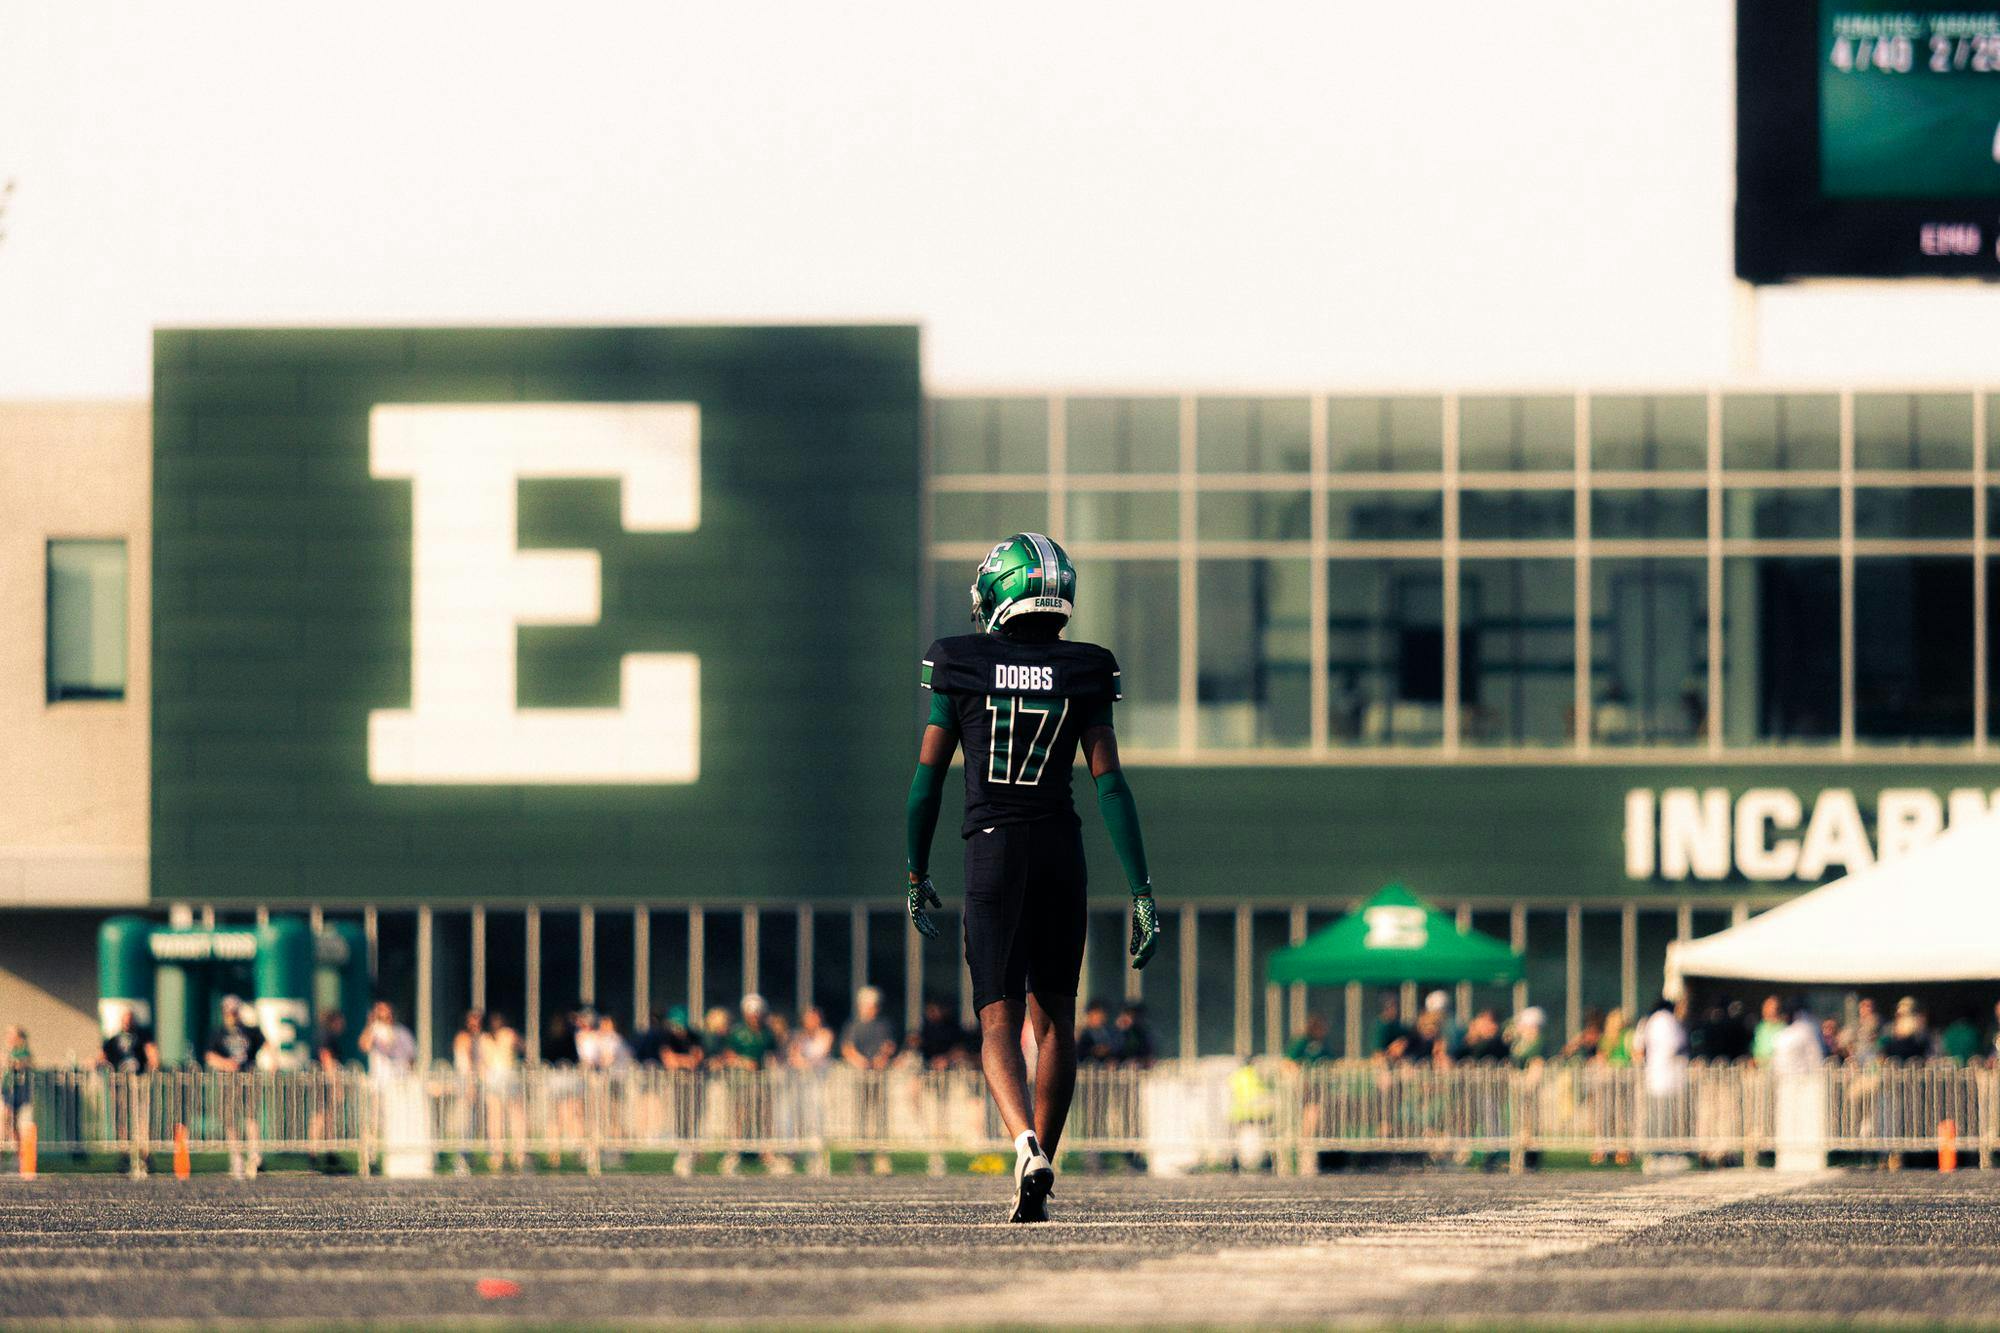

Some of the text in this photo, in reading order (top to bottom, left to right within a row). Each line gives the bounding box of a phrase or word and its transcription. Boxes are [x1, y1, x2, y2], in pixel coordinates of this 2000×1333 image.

[369, 402, 700, 785] E
[1034, 598, 1063, 609] EAGLES
[995, 663, 1053, 691] DOBBS
[985, 694, 1069, 786] 17
[1624, 787, 2000, 881] INCAR
